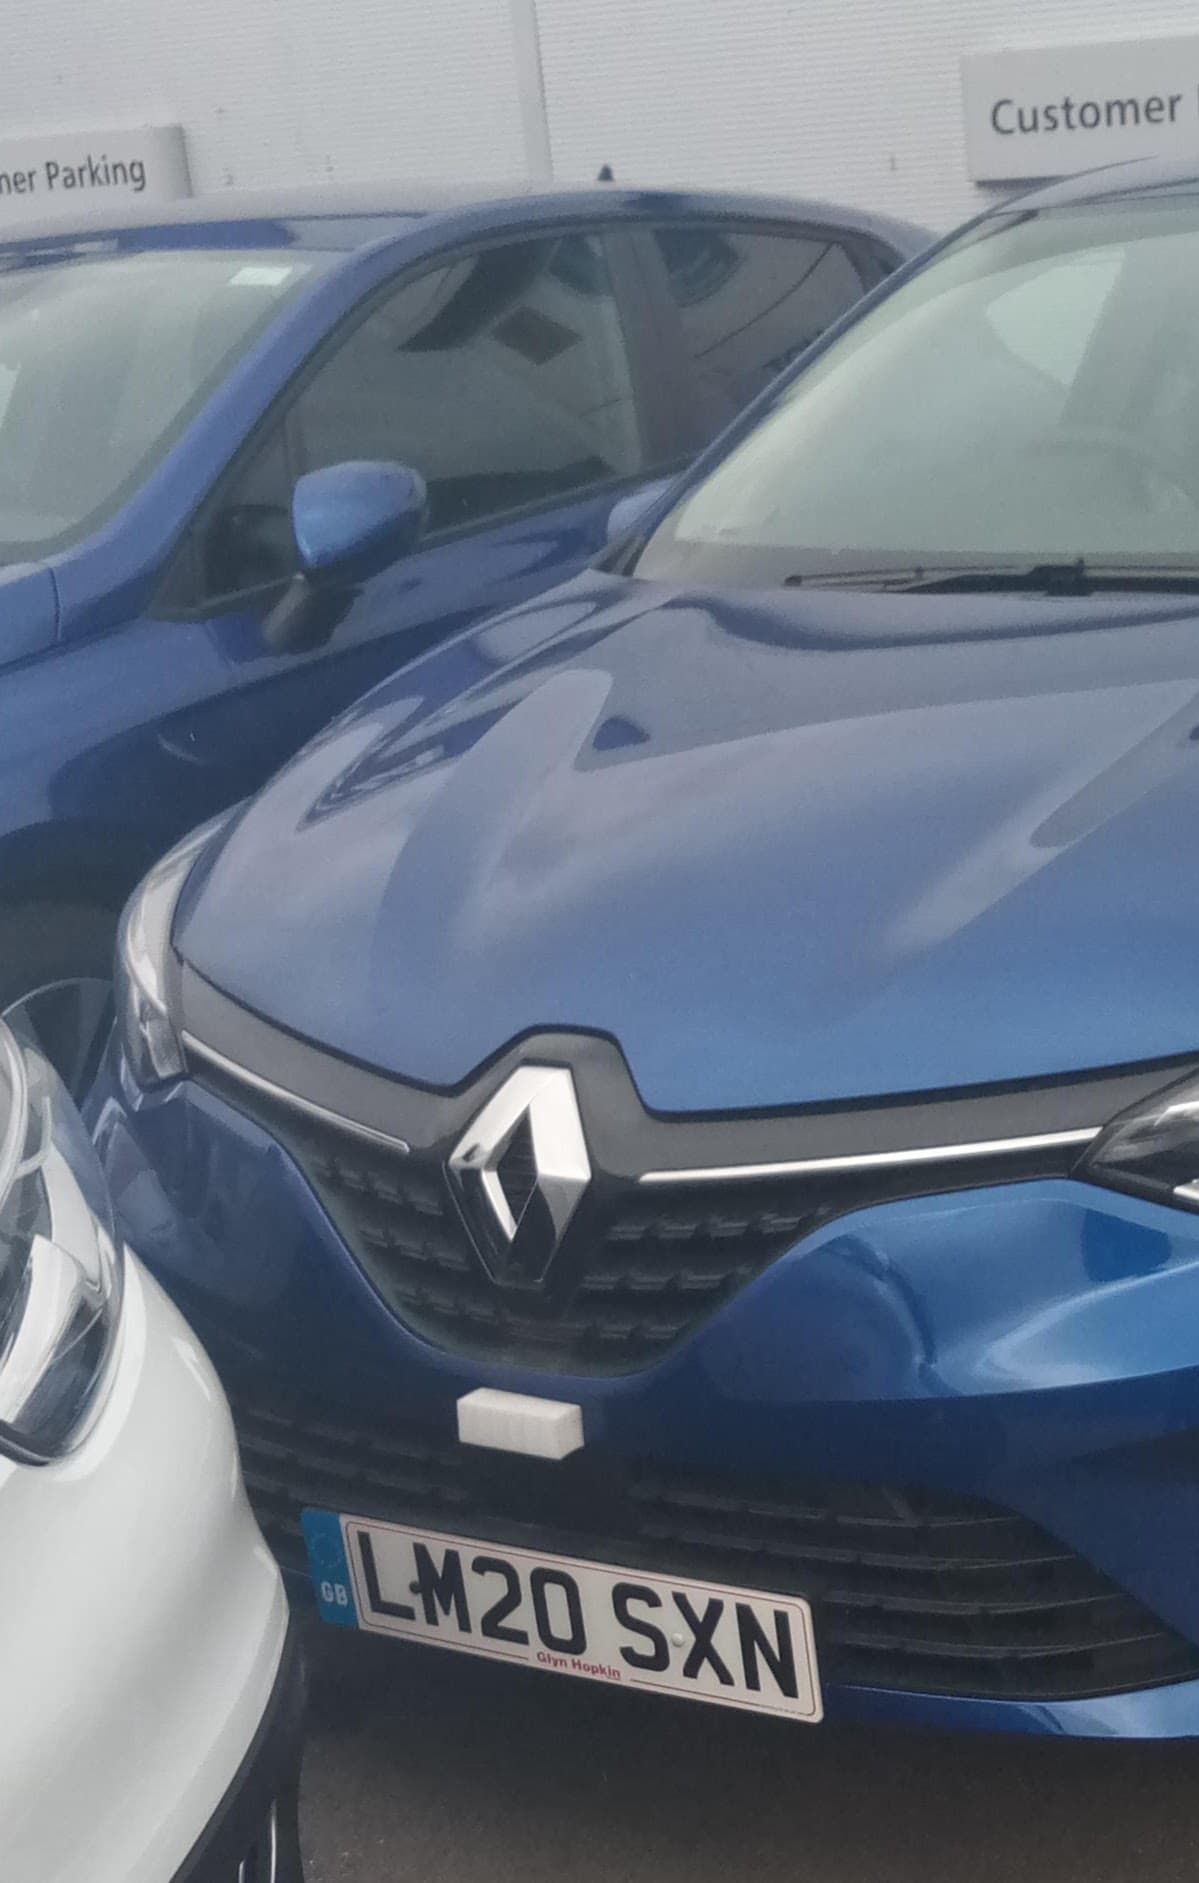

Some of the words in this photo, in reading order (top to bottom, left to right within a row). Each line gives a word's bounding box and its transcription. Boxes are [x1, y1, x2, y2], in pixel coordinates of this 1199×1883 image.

[991, 92, 1183, 134] Customer
[45, 154, 146, 193] Parking
[321, 1580, 348, 1608] GB
[357, 1530, 588, 1656] LM20
[610, 1581, 800, 1699] SXN
[536, 1651, 568, 1669] Glyn
[571, 1657, 622, 1680] Hopkin
